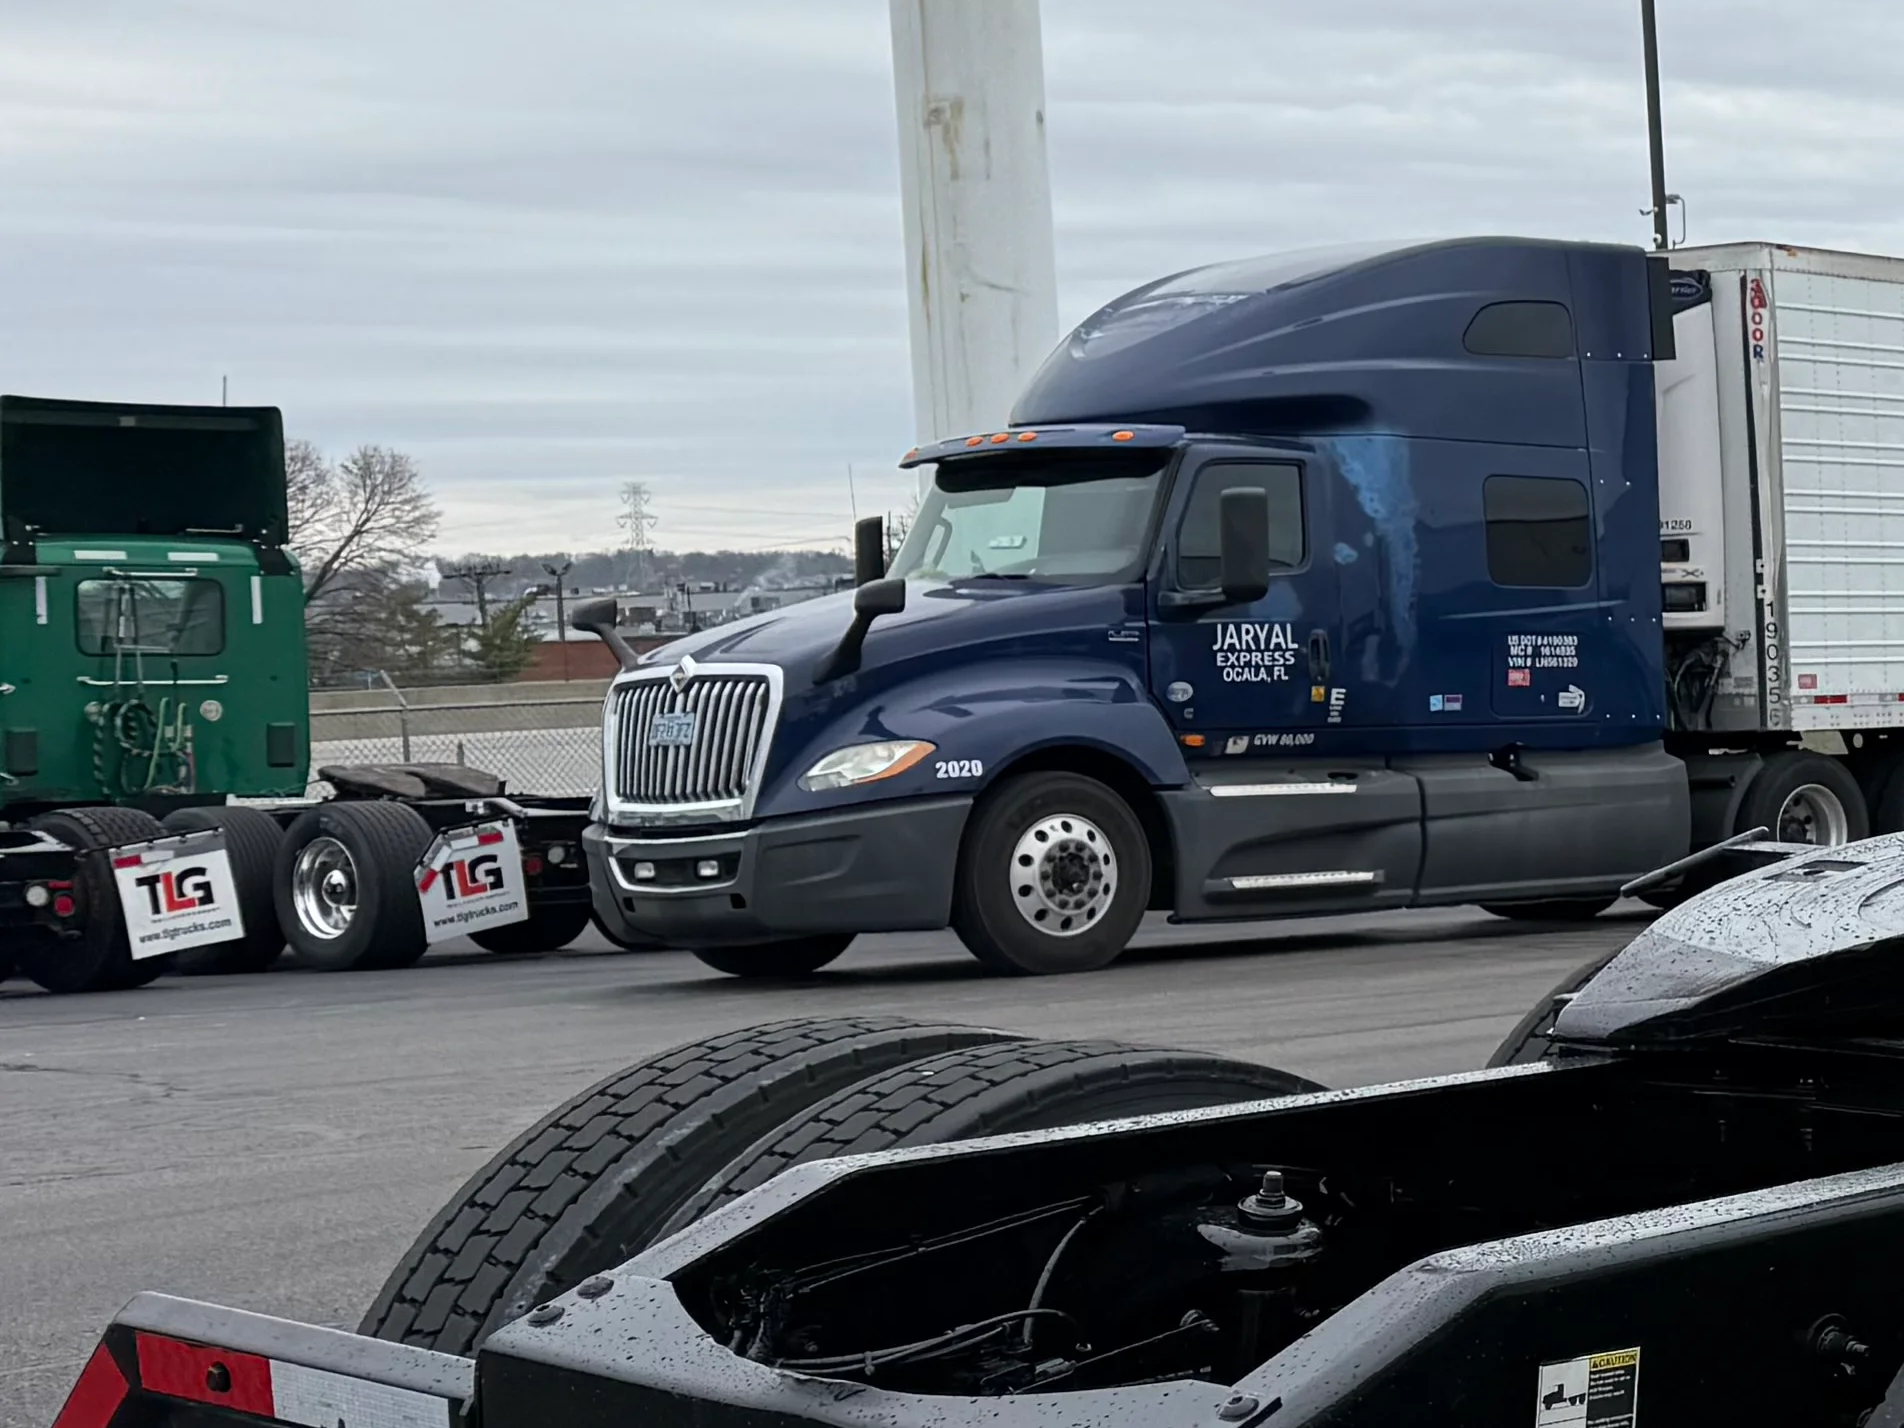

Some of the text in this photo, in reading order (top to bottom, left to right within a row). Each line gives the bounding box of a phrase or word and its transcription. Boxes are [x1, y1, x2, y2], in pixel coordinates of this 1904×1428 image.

[1212, 623, 1299, 651] JARYAL
[1216, 651, 1295, 666] EXPRESS
[1223, 666, 1289, 683] OCALA, FL
[935, 759, 983, 778] 2020
[440, 854, 504, 900] TLG
[135, 867, 215, 915] TLG
[1598, 1353, 1637, 1369] CAUTION
